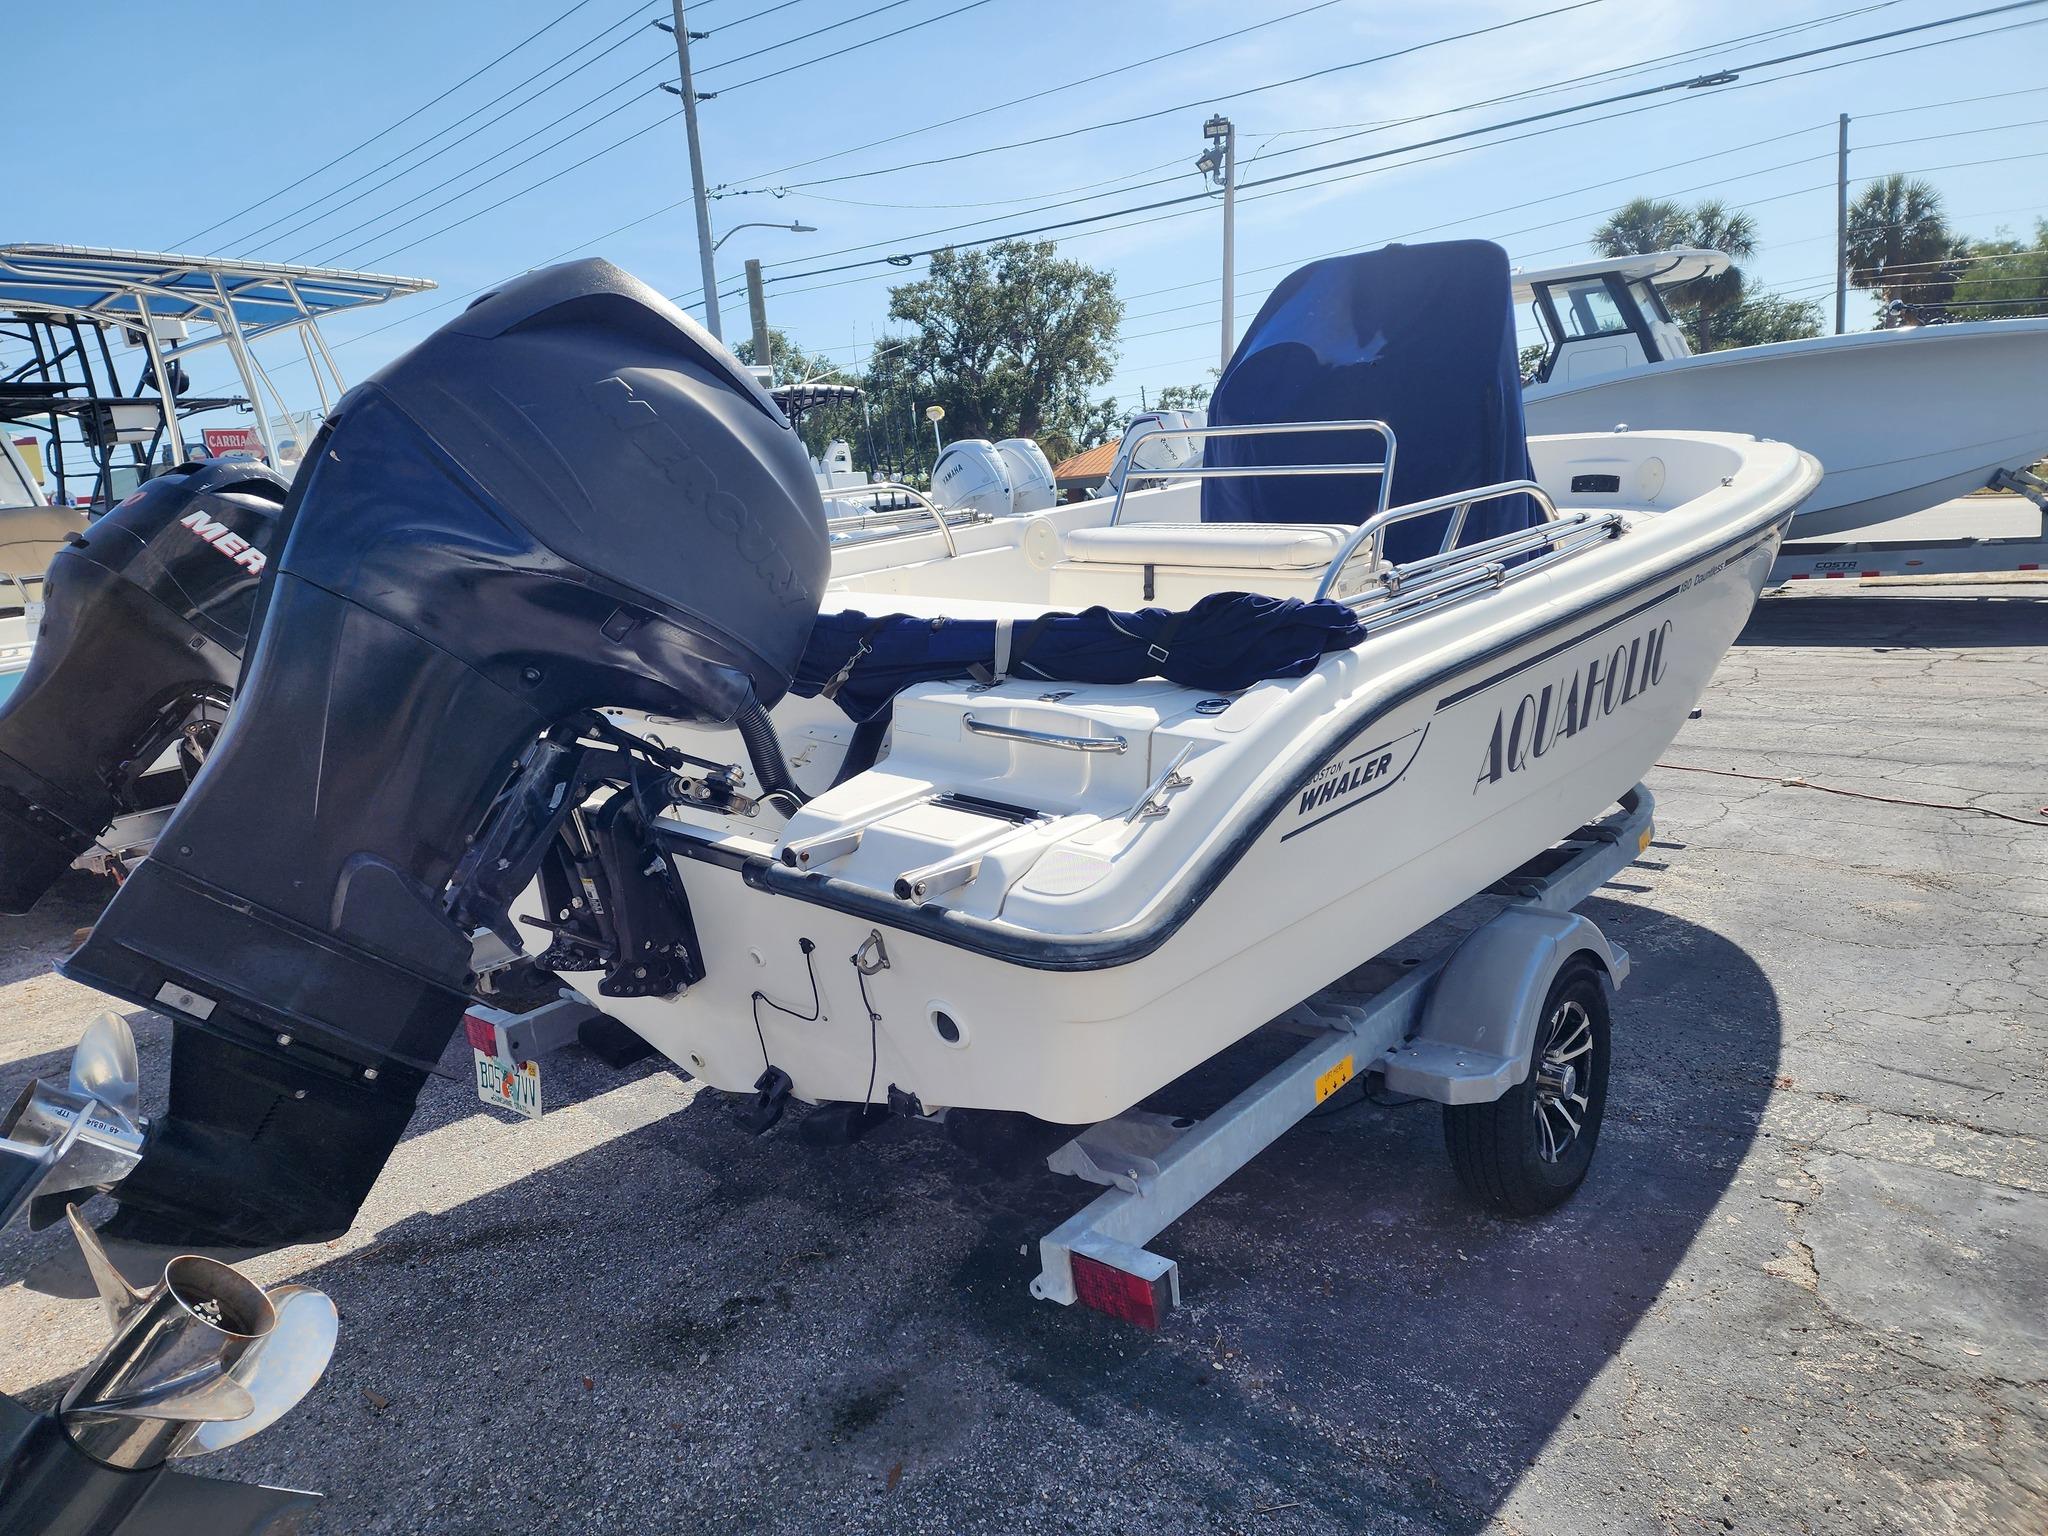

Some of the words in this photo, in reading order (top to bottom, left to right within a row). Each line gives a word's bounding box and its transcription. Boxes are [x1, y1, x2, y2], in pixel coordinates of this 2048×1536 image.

[942, 463, 964, 484] YAMAHA
[1473, 619, 1673, 796] AQUAHOLIC
[1298, 752, 1393, 816] WHALER
